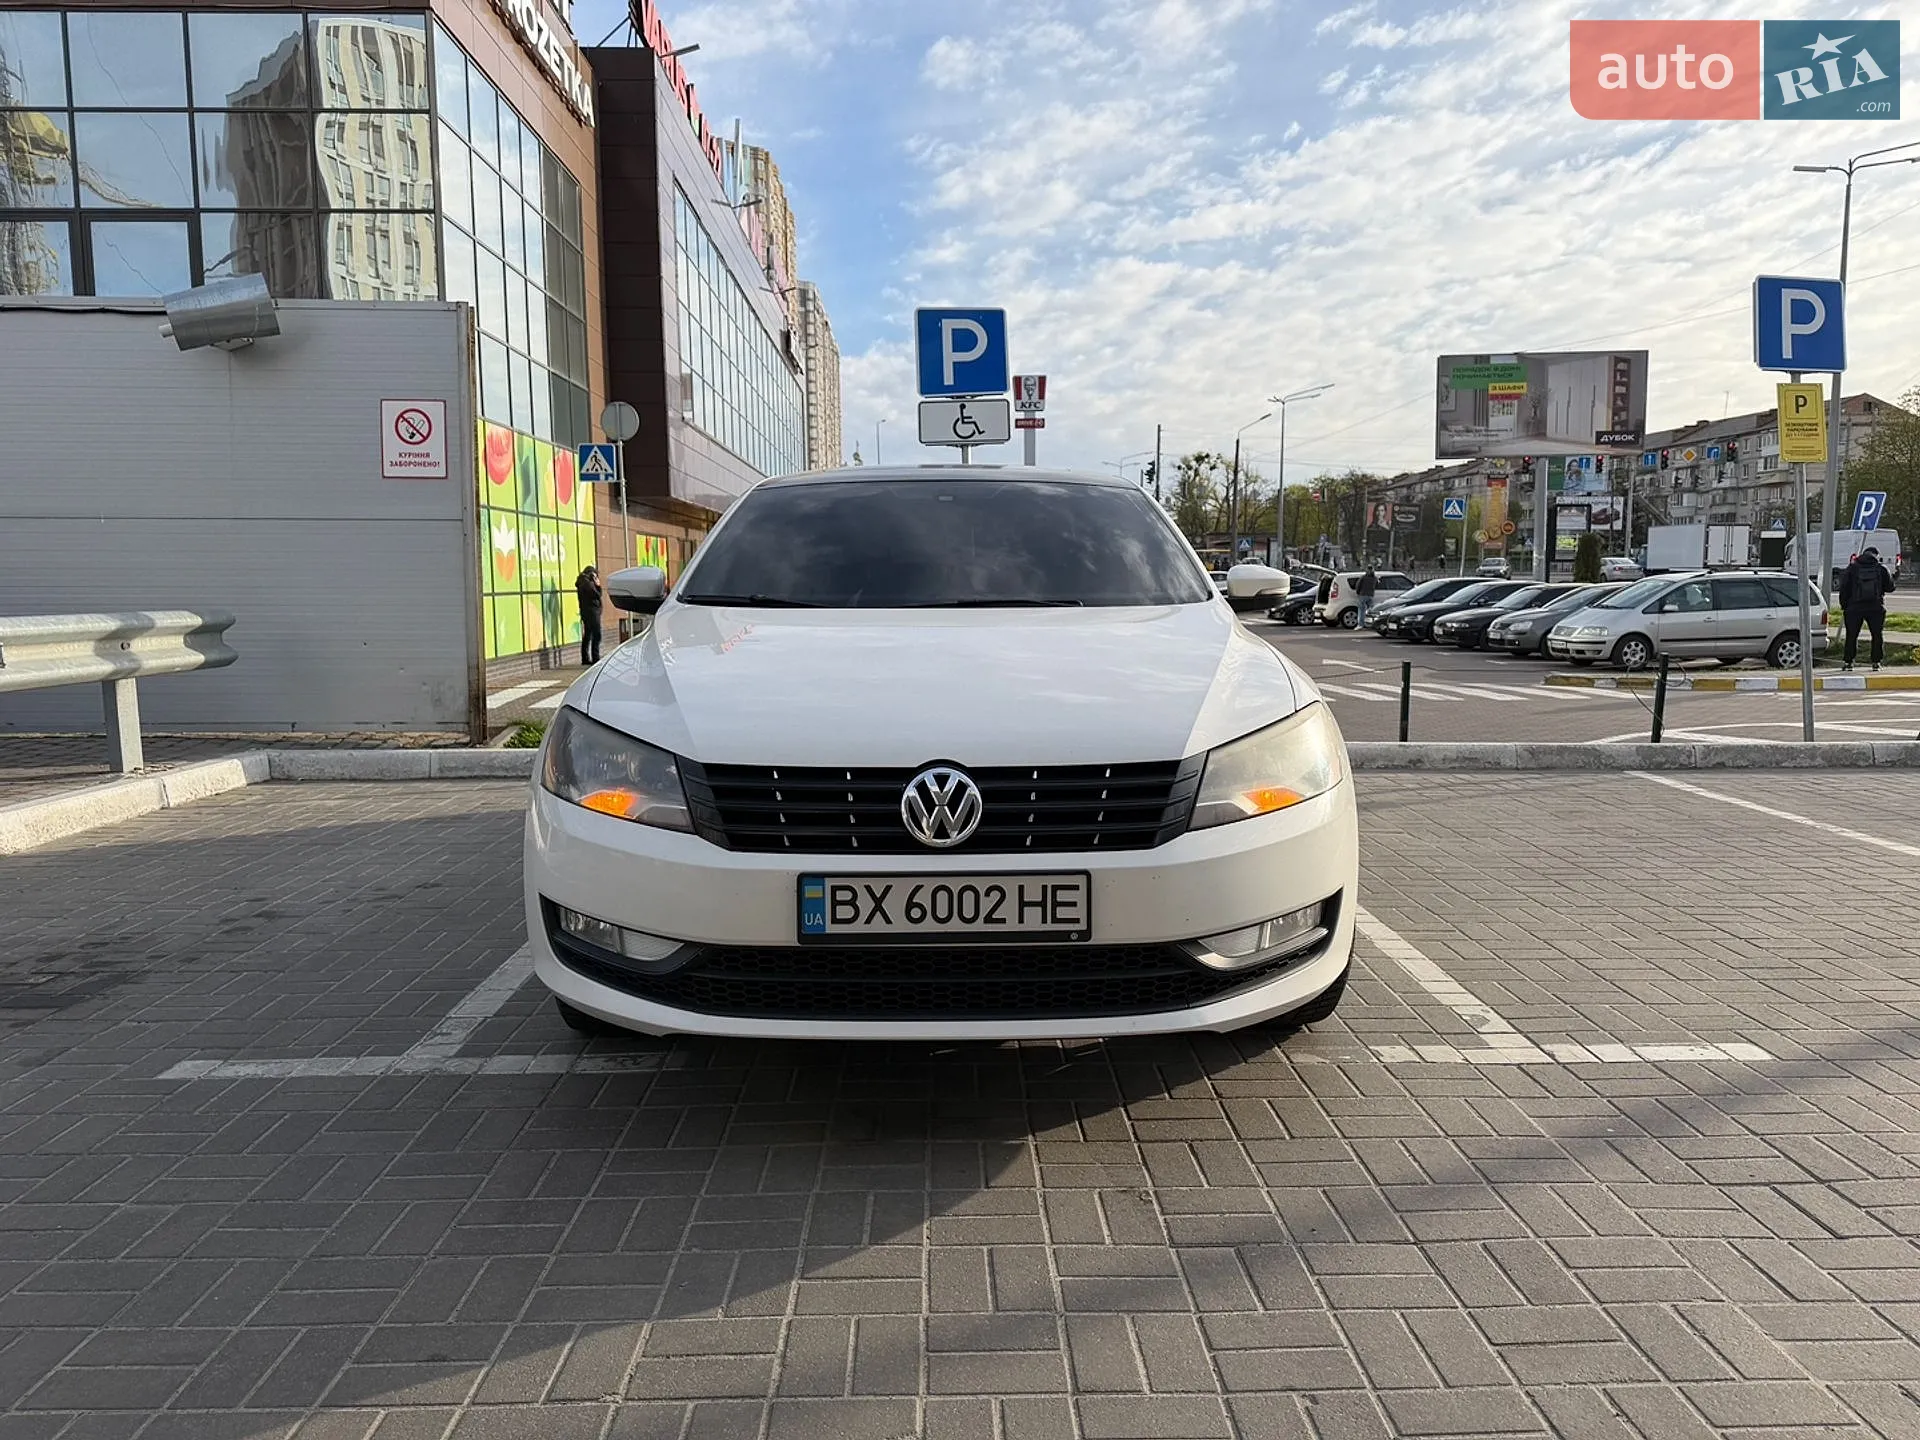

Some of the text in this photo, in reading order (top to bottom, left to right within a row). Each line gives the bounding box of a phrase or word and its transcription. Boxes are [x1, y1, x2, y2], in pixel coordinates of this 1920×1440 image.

[1781, 287, 1826, 359] P
[941, 318, 988, 385] P
[1020, 401, 1041, 409] KFC
[1795, 395, 1808, 414] P
[1600, 434, 1635, 442] ДУБОК
[389, 460, 440, 468] ЗАБОРОНЕНО!
[1858, 496, 1877, 527] P
[519, 529, 566, 563] VARUS
[829, 884, 1081, 925] BX 6002 HE
[804, 912, 824, 926] UA
